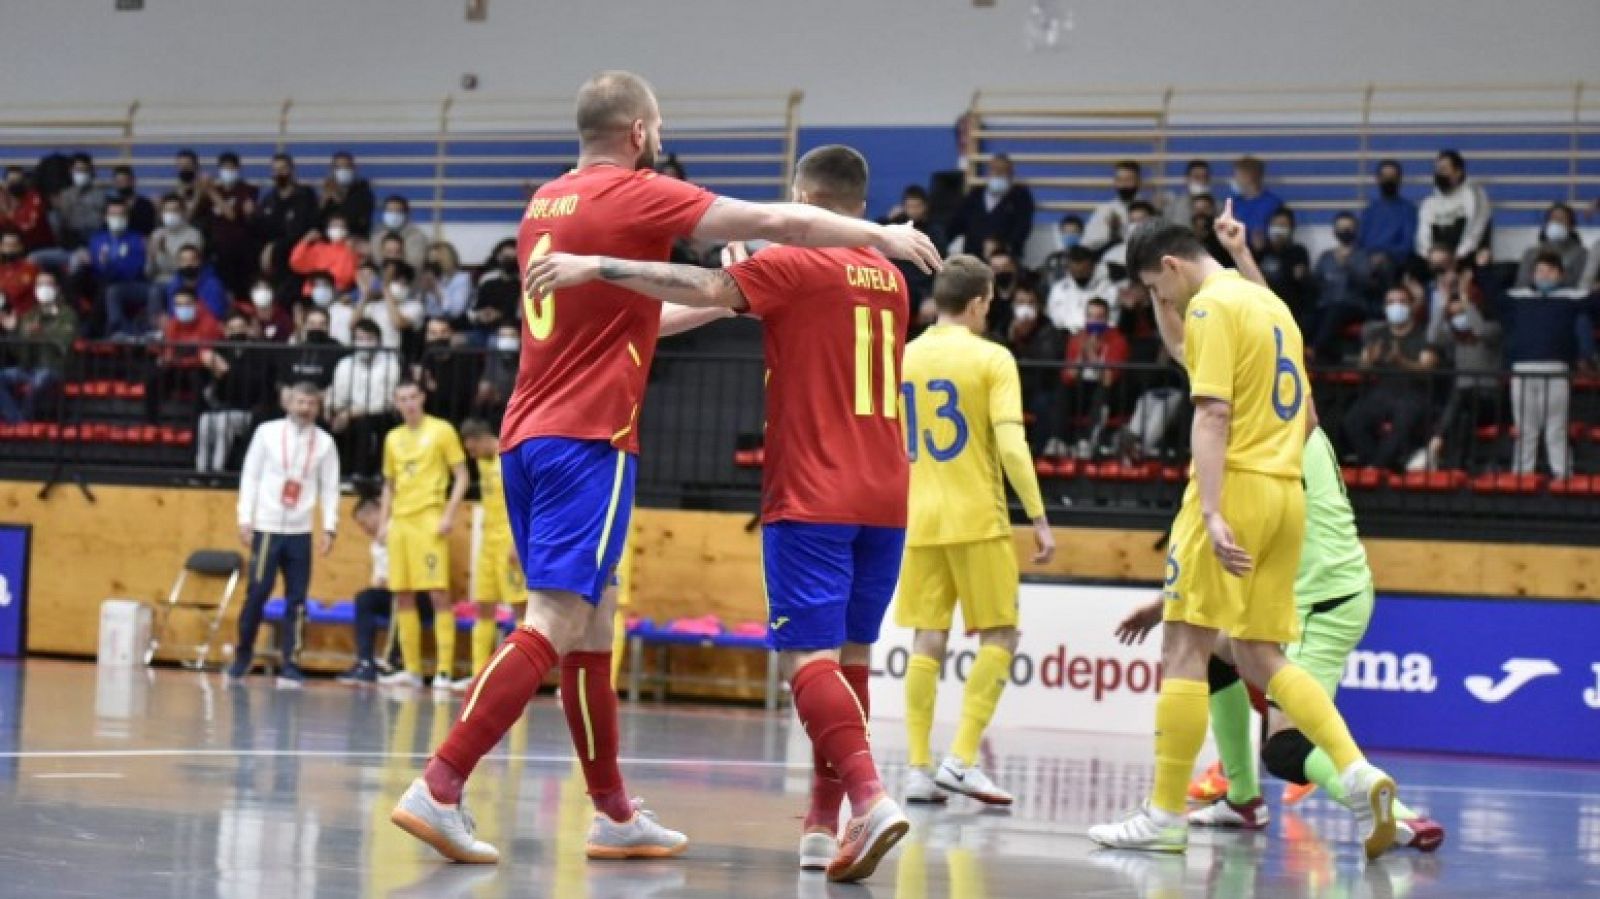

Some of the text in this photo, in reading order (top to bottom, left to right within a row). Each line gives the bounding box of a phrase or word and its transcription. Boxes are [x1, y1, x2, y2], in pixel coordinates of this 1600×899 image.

[845, 264, 898, 292] CATELA
[855, 306, 898, 419] 11
[1272, 325, 1302, 421] 6
[900, 379, 969, 463] 13
